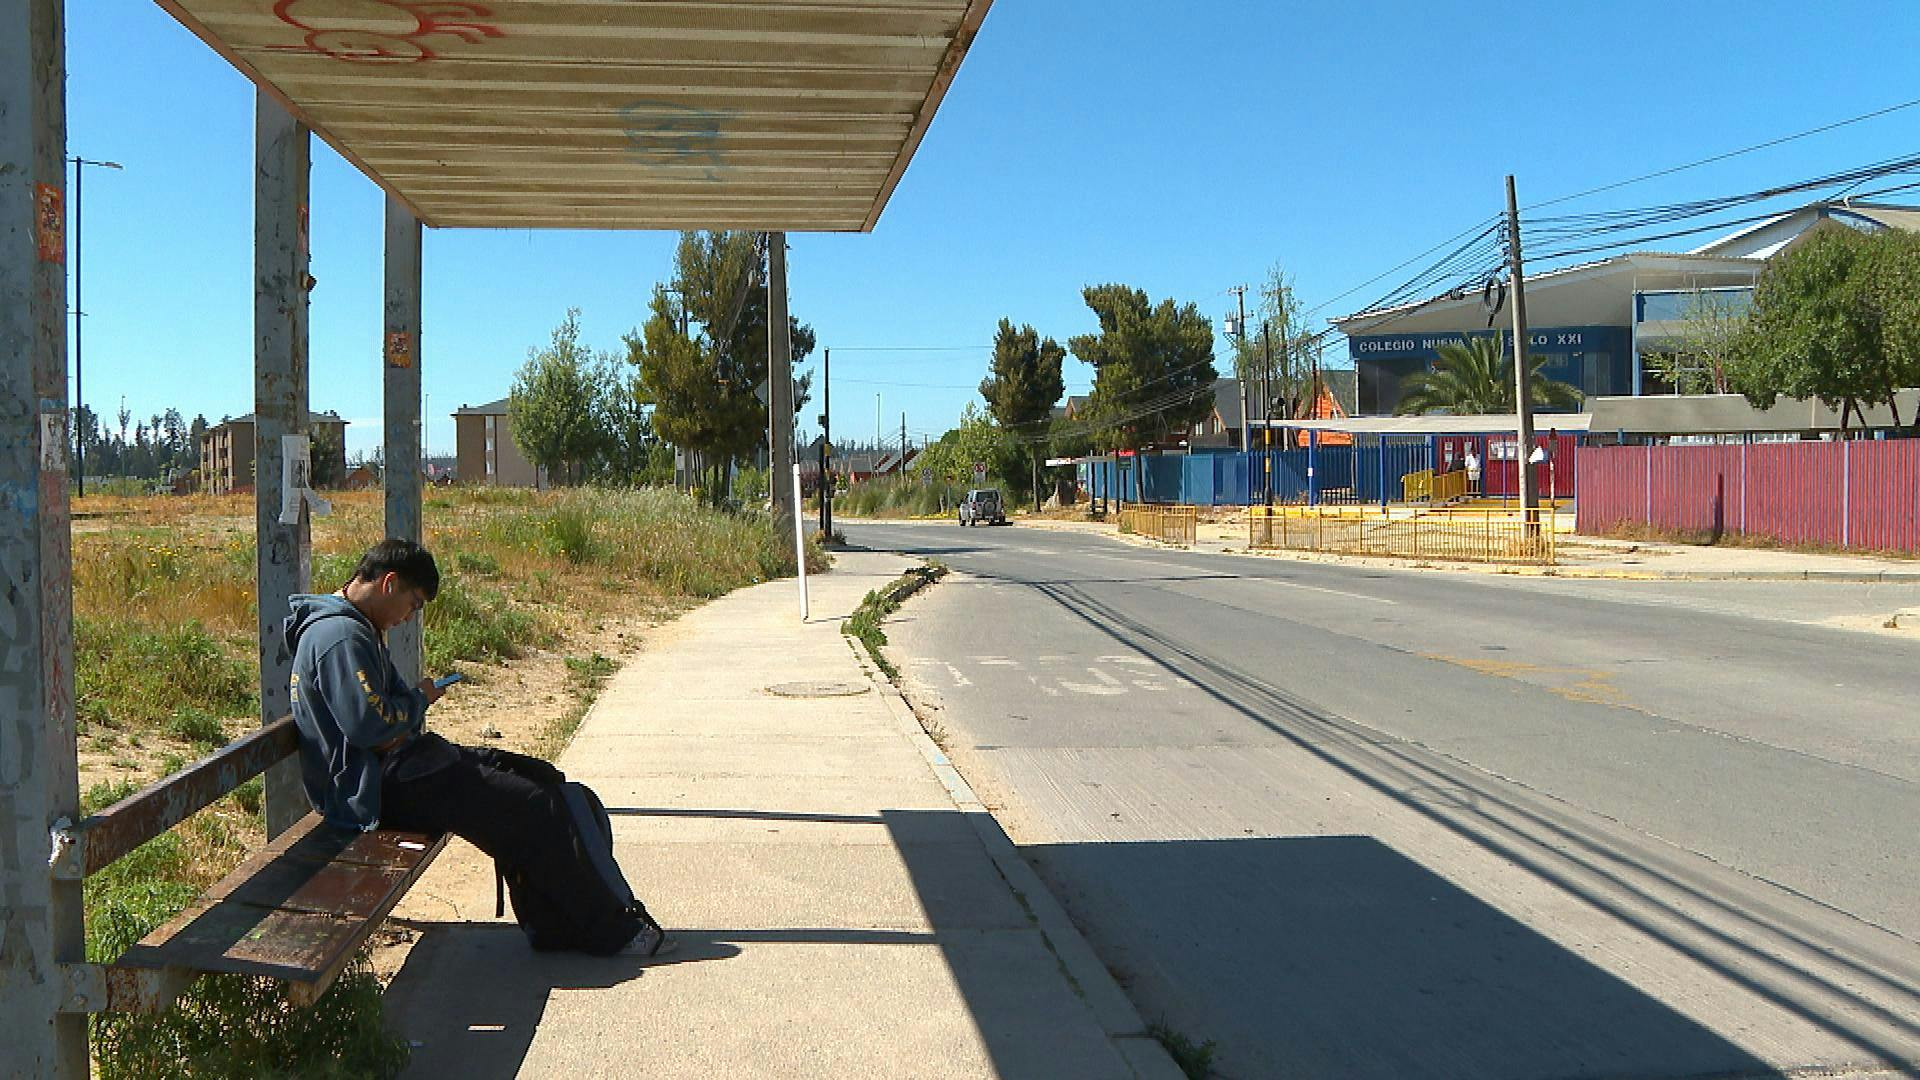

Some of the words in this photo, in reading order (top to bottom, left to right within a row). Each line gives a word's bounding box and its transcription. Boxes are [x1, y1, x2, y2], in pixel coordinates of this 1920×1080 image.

[1360, 339, 1415, 352] COLEGIO
[1507, 334, 1548, 347] SLO
[1558, 333, 1582, 346] XXI
